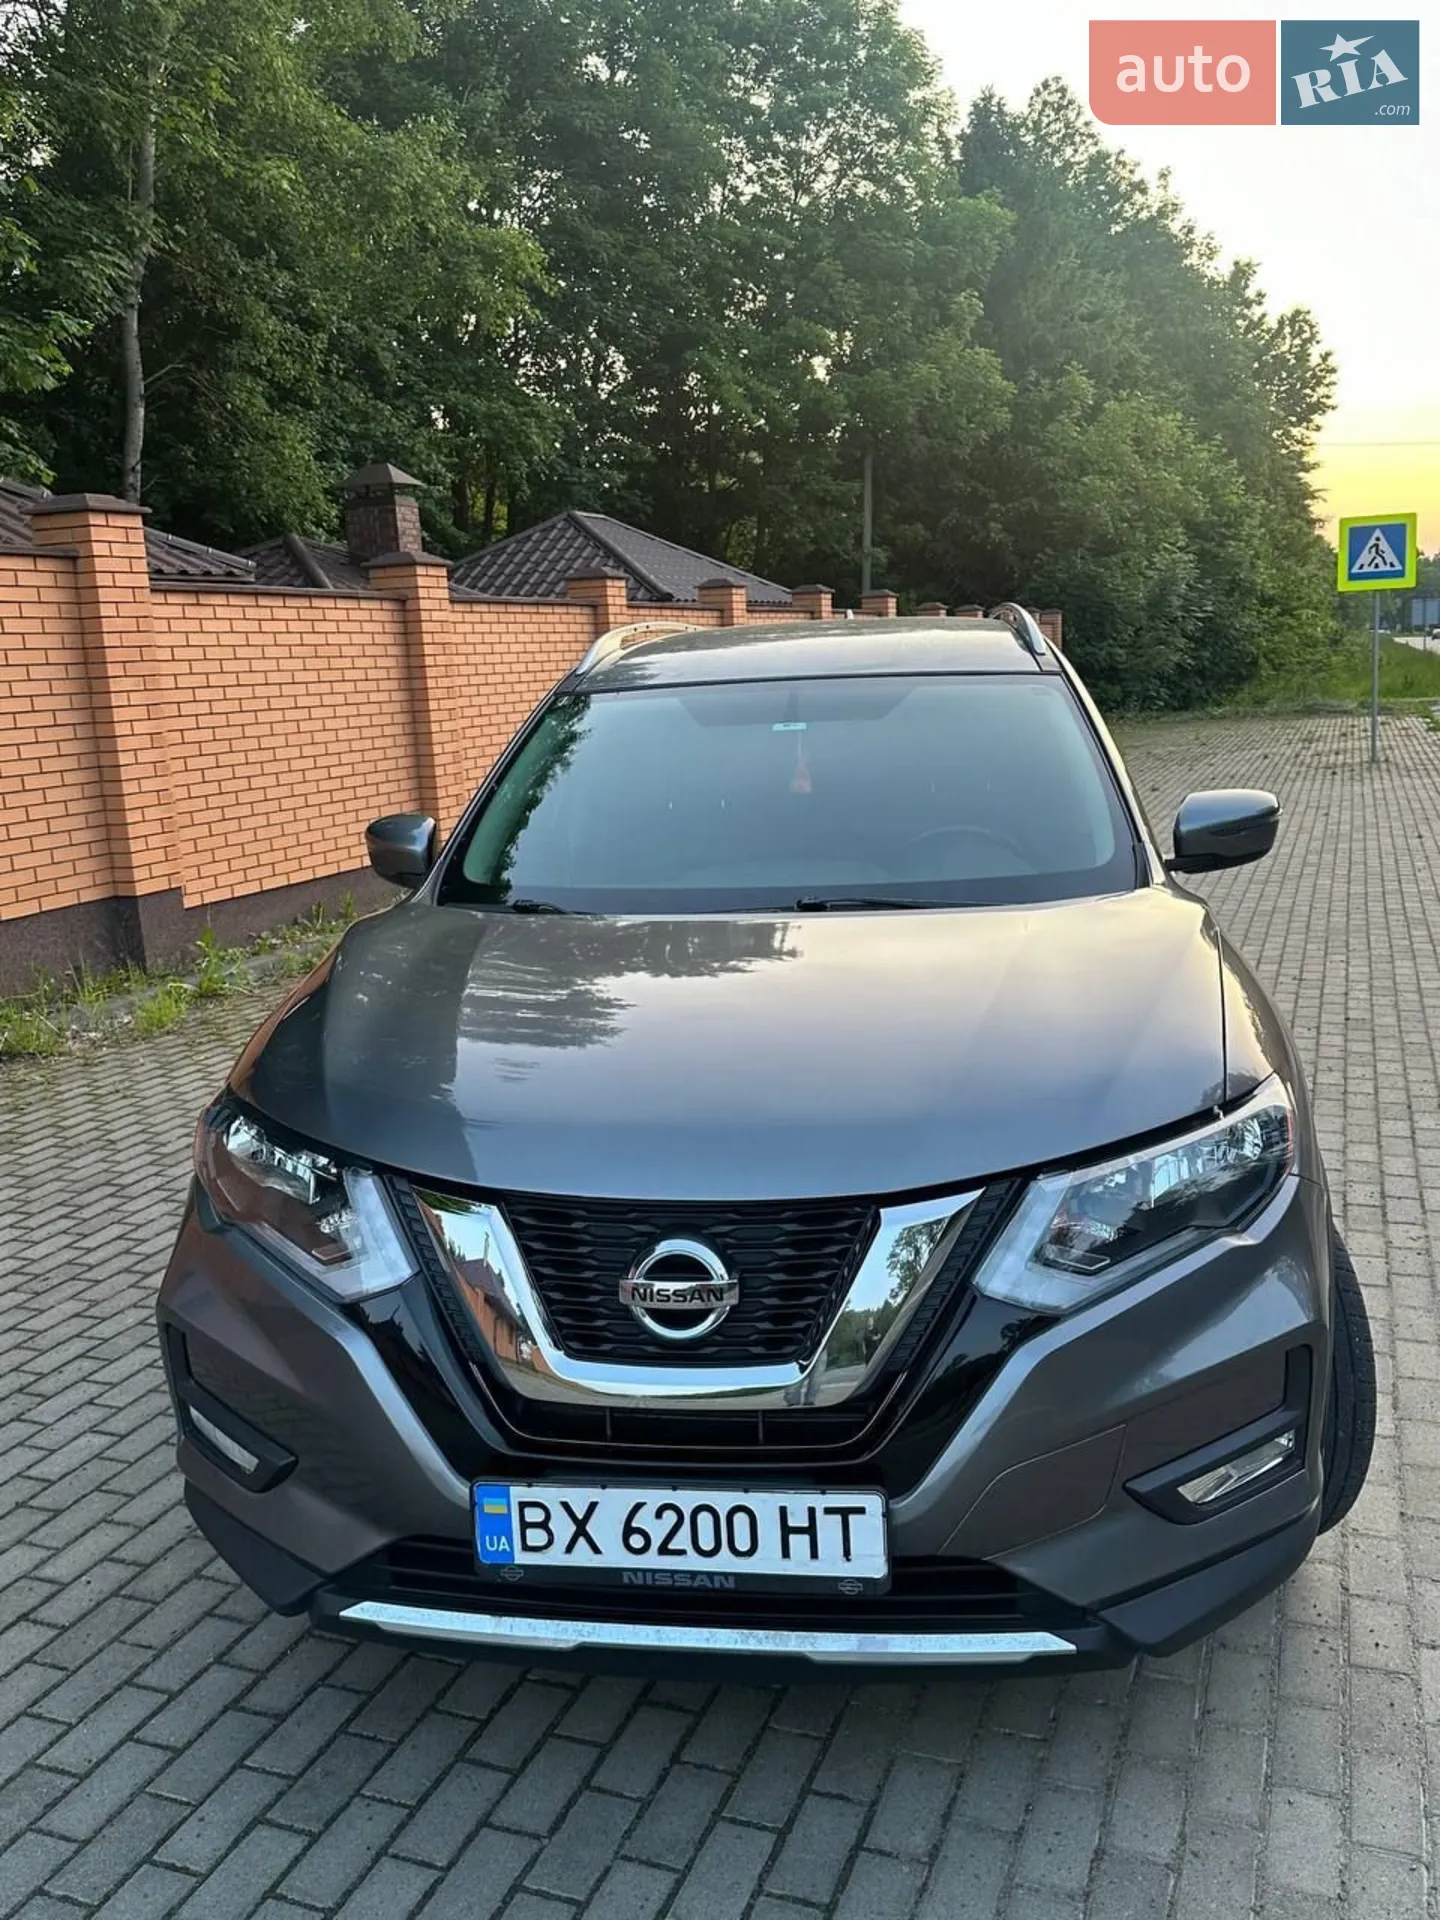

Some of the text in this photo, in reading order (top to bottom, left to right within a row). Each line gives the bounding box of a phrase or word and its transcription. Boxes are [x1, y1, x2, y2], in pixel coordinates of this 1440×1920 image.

[631, 1287, 724, 1303] NISSAN
[517, 1500, 867, 1562] BX 6200 HT
[486, 1535, 511, 1553] UA
[622, 1571, 735, 1588] NISSAN
